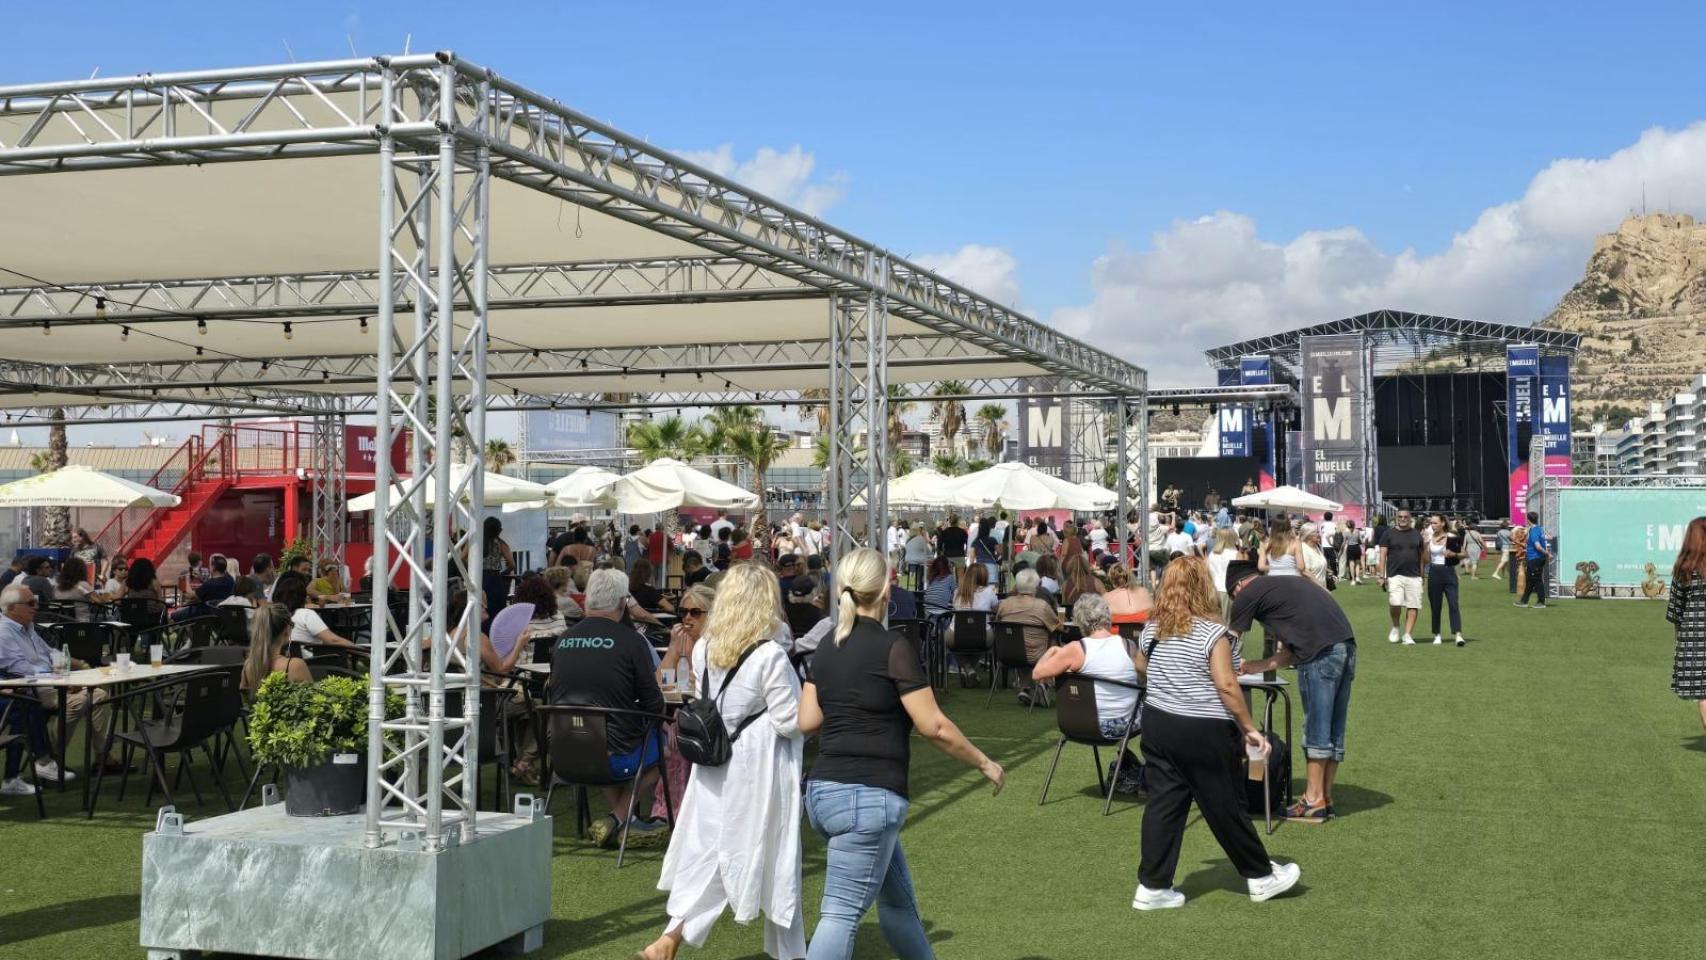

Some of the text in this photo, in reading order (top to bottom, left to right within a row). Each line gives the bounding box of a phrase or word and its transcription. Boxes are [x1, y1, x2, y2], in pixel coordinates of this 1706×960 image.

[1313, 374, 1351, 394] E L
[1543, 384, 1566, 396] E L
[1543, 397, 1567, 423] M
[1028, 406, 1062, 448] M
[1222, 408, 1243, 432] M
[1313, 397, 1352, 441] M
[1029, 456, 1038, 465] EL
[1315, 449, 1326, 460] EL
[1315, 461, 1352, 472] MUELLE
[1315, 473, 1336, 484] LIVE
